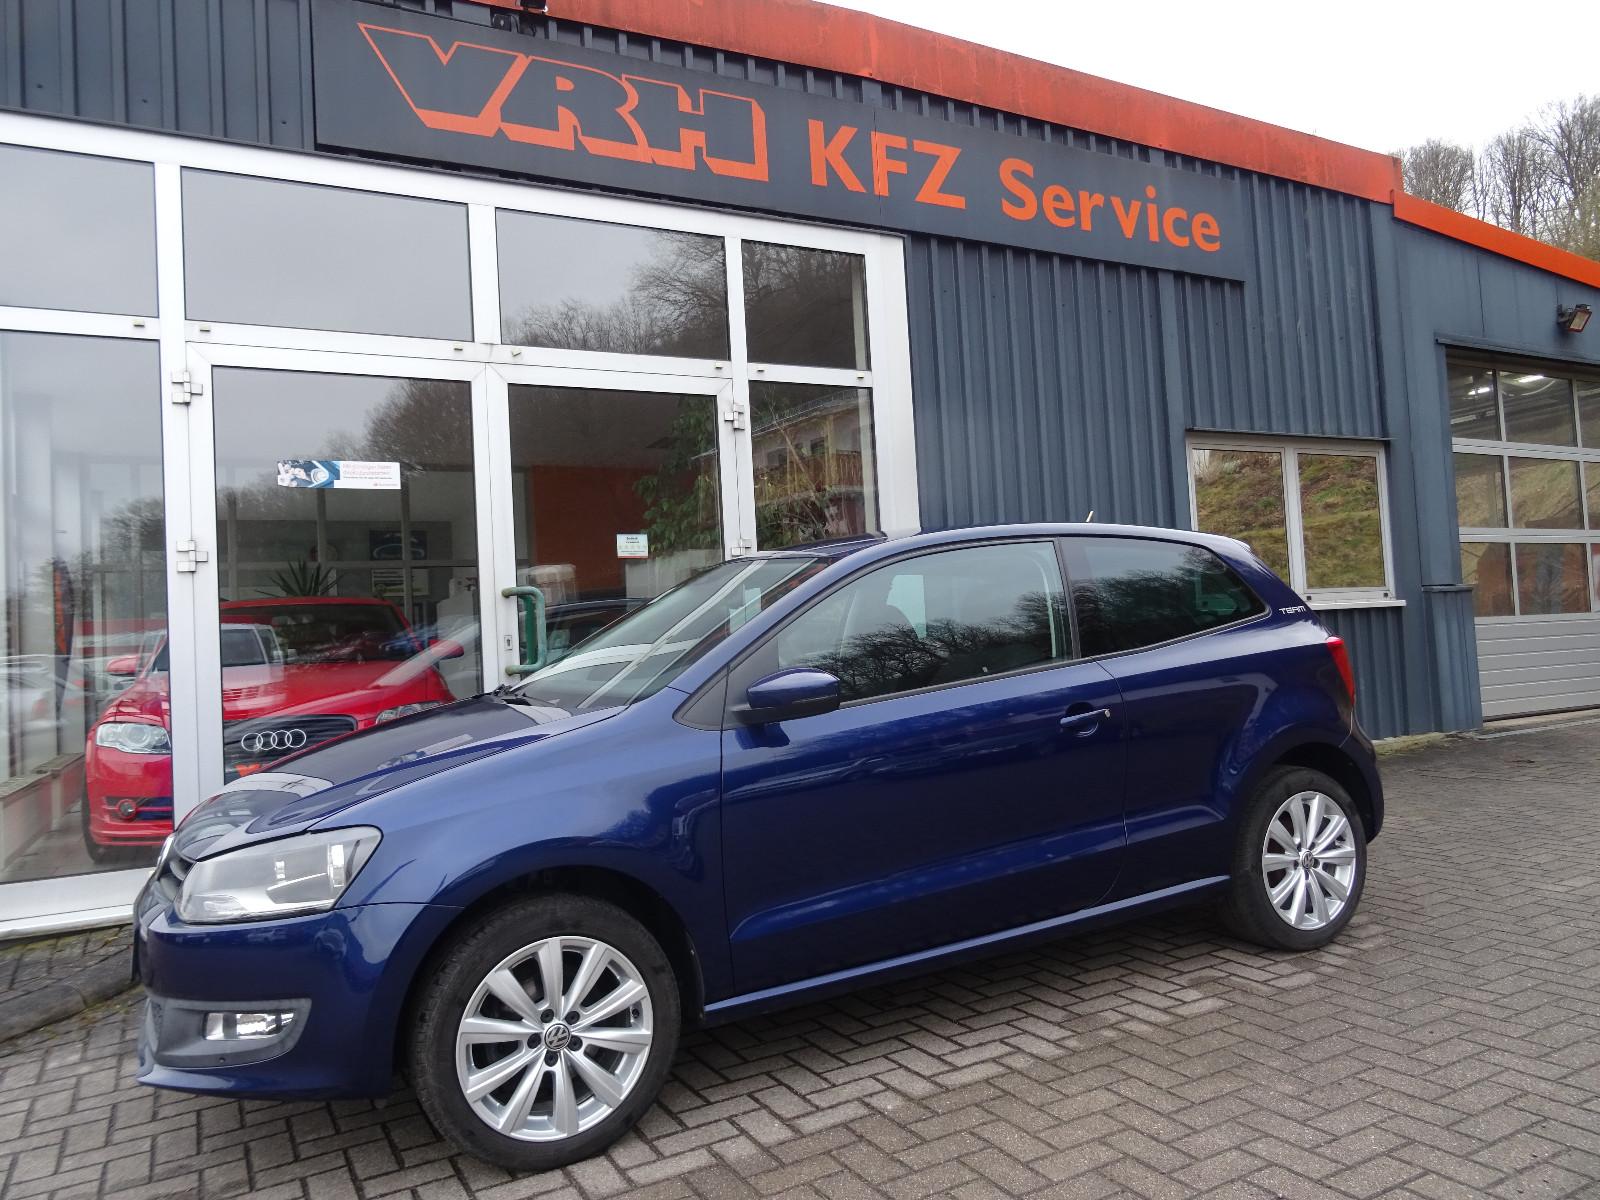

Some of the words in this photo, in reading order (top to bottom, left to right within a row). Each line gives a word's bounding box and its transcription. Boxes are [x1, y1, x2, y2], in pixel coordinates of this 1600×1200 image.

[357, 23, 769, 182] VRH
[808, 118, 967, 210] KFZ
[1000, 157, 1221, 252] Service
[1278, 605, 1306, 615] TEAM
